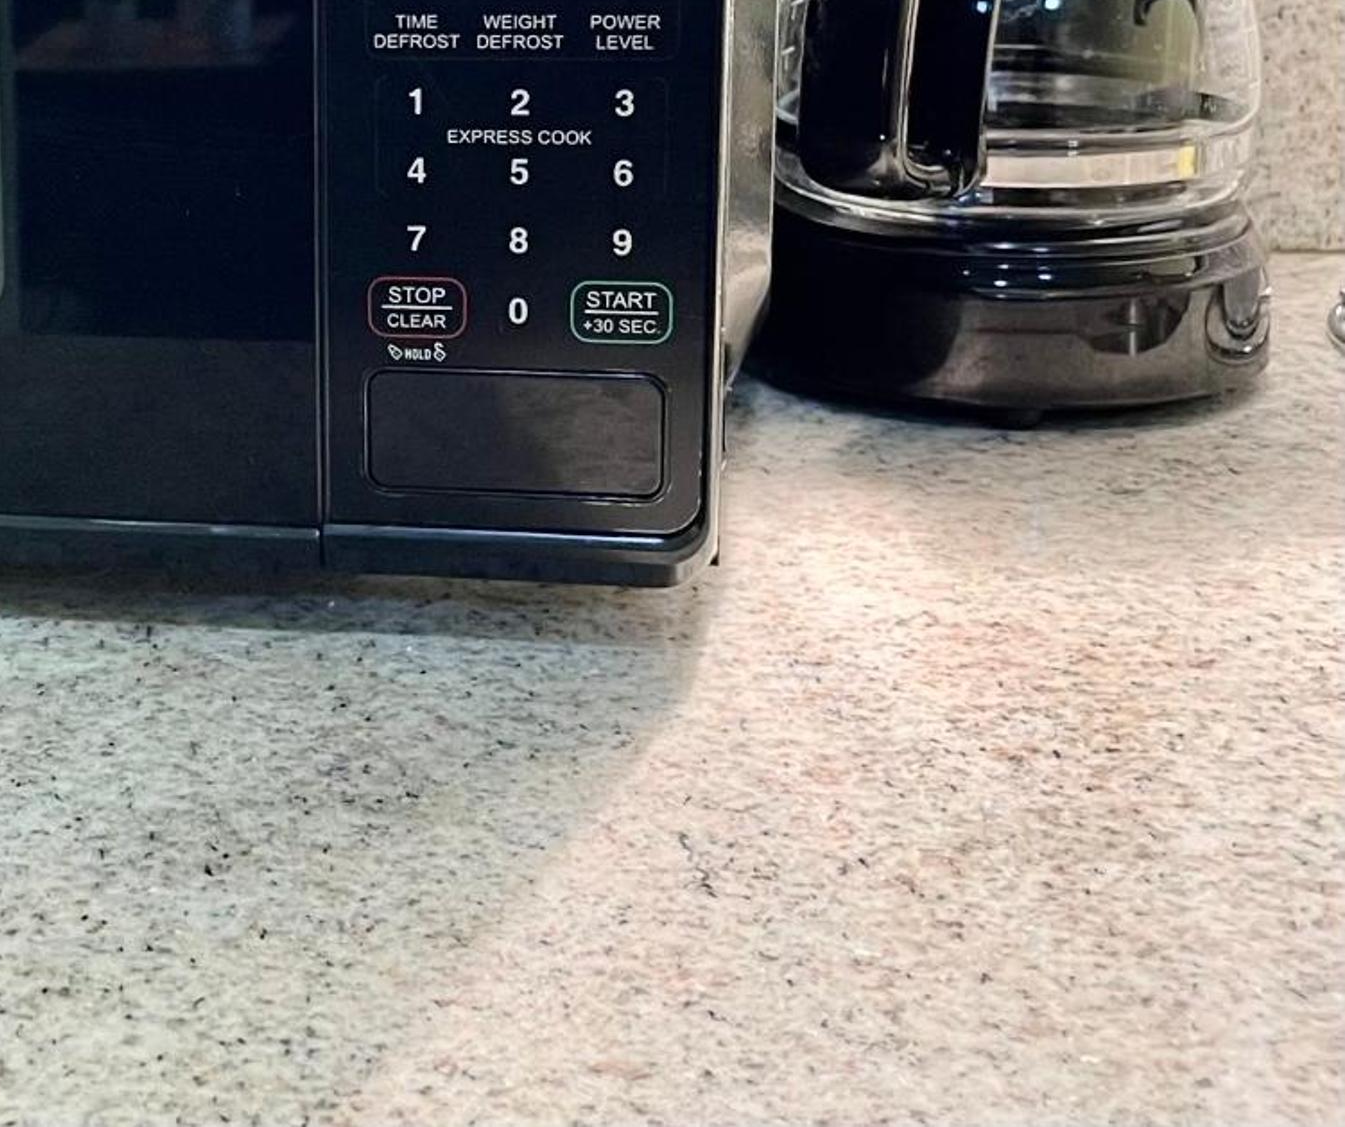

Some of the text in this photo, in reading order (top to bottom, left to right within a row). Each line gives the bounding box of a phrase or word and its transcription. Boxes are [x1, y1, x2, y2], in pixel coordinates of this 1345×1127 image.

[394, 14, 438, 30] TIME
[483, 13, 558, 30] WEIGHT
[590, 14, 661, 31] POWER
[373, 33, 461, 49] DEFROST
[476, 34, 565, 50] DEFROST
[595, 34, 654, 51] LEVEL
[408, 87, 422, 115] 1
[510, 88, 530, 116] 2
[614, 88, 635, 117] 3
[446, 128, 592, 146] EXPRESS COOK
[406, 156, 427, 184] 4
[510, 158, 529, 185] 5
[613, 159, 634, 187] 6
[406, 225, 427, 252] 7
[508, 226, 529, 254] 8
[612, 228, 633, 256] 9
[388, 285, 446, 304] STOP
[586, 290, 658, 309] START
[386, 312, 447, 329] CLEAR
[508, 297, 529, 325] 0
[583, 318, 614, 334] +30
[404, 348, 432, 361] HOLD
